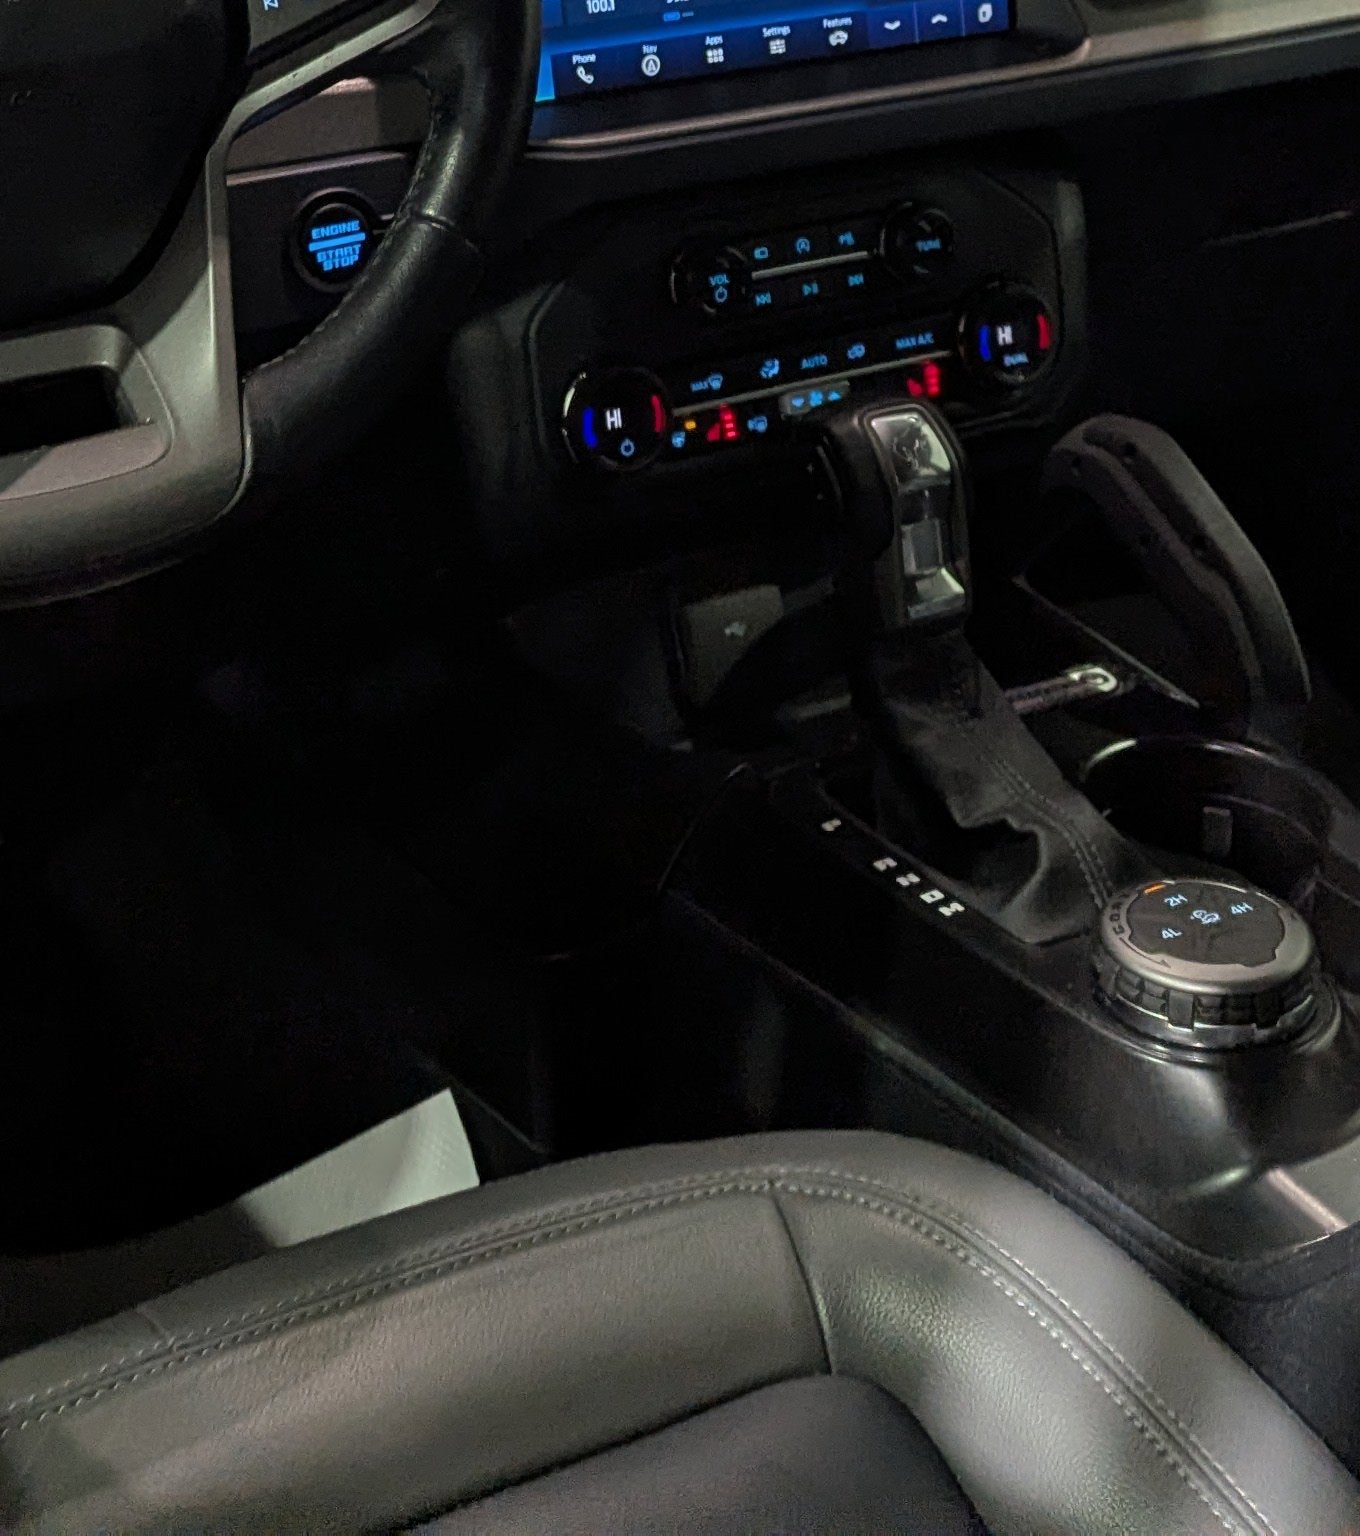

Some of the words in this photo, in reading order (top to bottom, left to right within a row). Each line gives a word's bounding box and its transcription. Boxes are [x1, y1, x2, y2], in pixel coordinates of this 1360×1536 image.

[823, 16, 853, 30] Features
[762, 26, 791, 38] Settings
[705, 35, 723, 47] Apps
[572, 53, 597, 64] Phone
[311, 220, 360, 240] ENGINE
[316, 244, 361, 263] START
[323, 254, 359, 272] STOP
[709, 273, 730, 286] VOL
[801, 354, 828, 370] AUTO
[605, 407, 622, 431] HI
[1164, 894, 1188, 907] 2H
[1230, 902, 1254, 915] 4H
[1161, 927, 1183, 940] 4L
